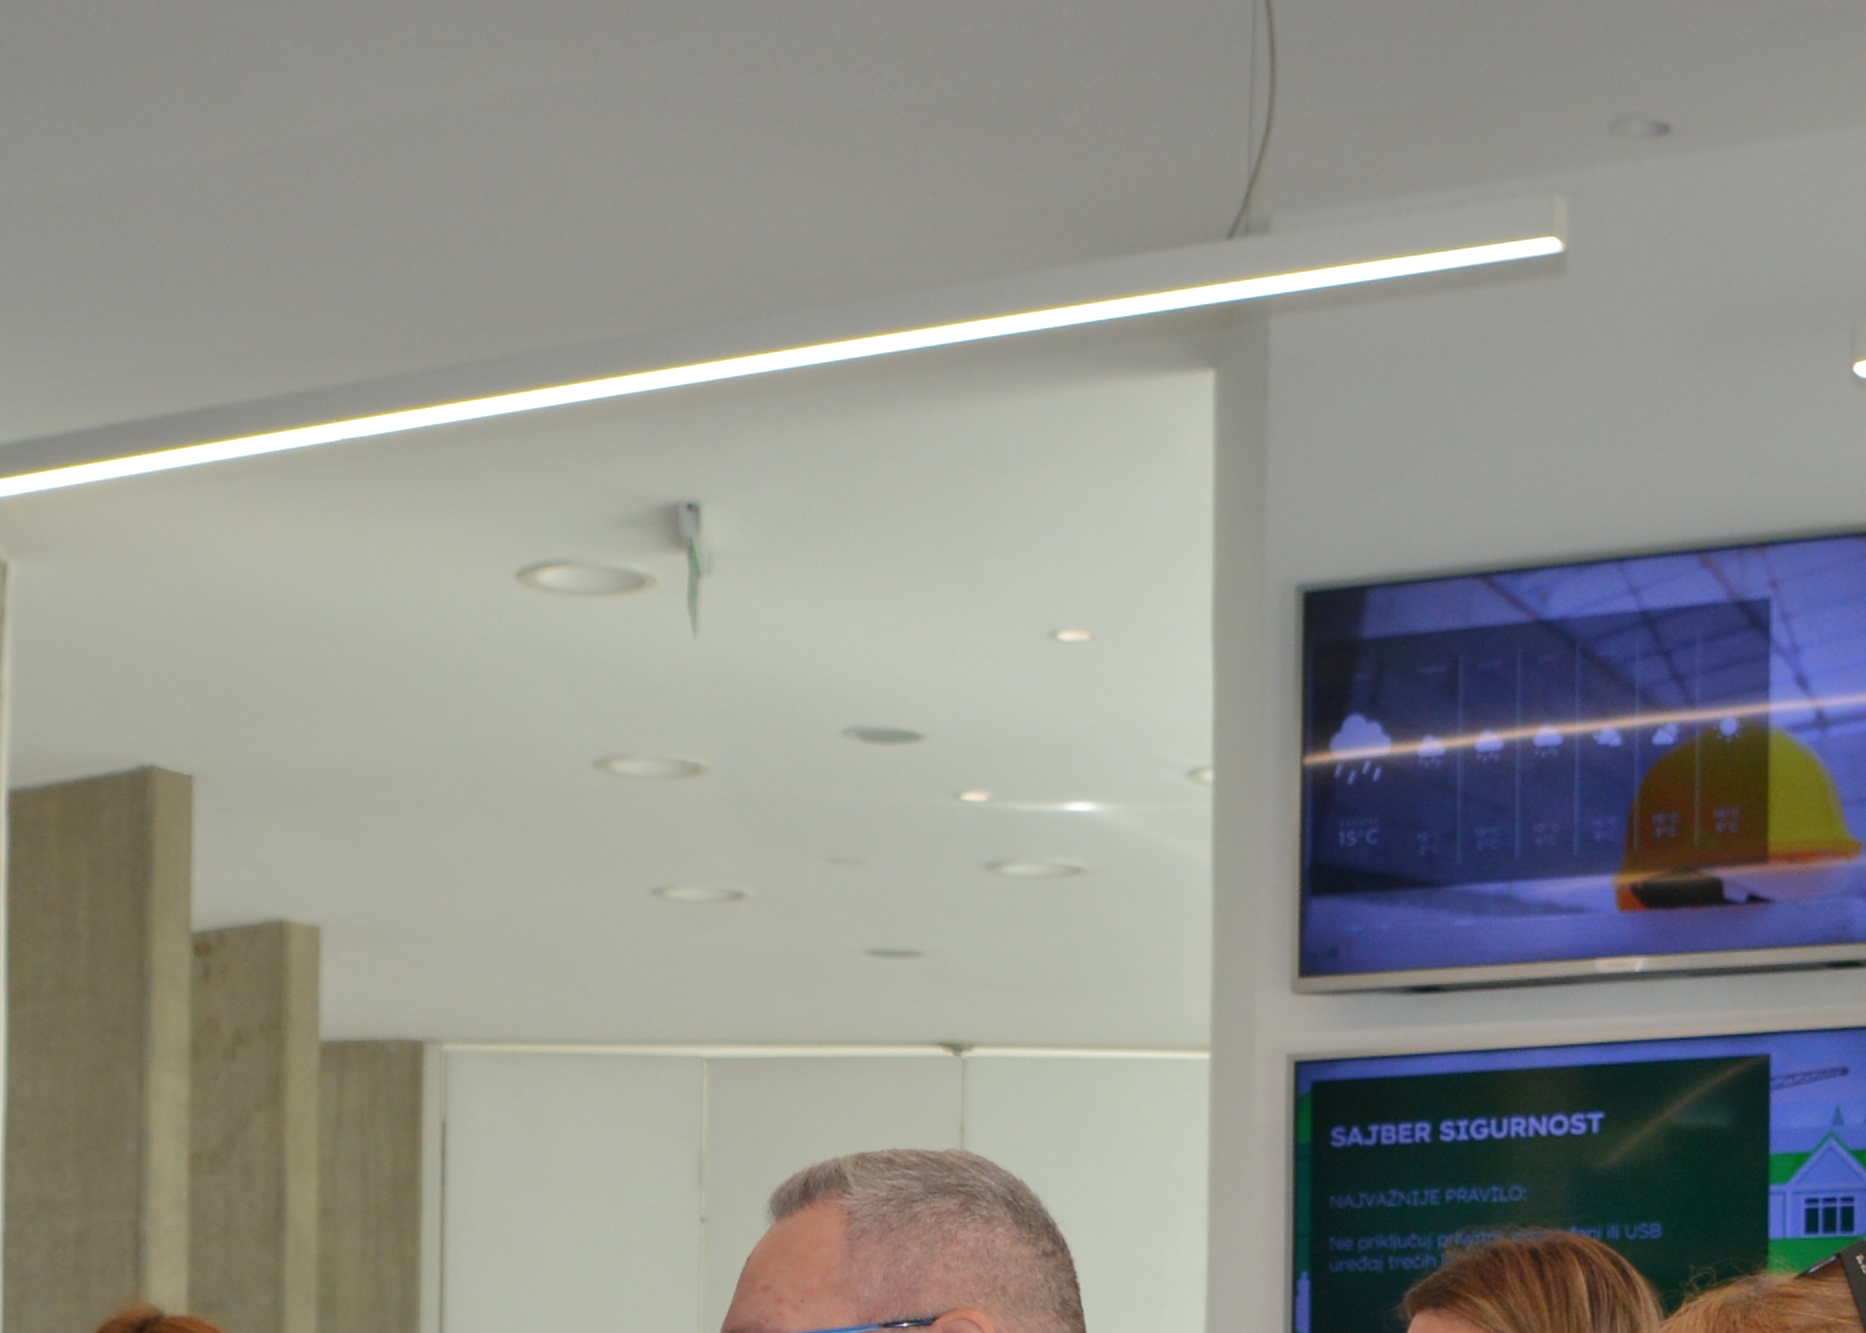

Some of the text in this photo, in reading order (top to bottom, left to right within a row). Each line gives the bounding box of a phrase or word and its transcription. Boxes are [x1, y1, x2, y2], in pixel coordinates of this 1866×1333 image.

[1330, 1110, 1607, 1149] SAJBER SIGURNOST
[1329, 1235, 1353, 1251] Ne
[1624, 1220, 1664, 1240] USB
